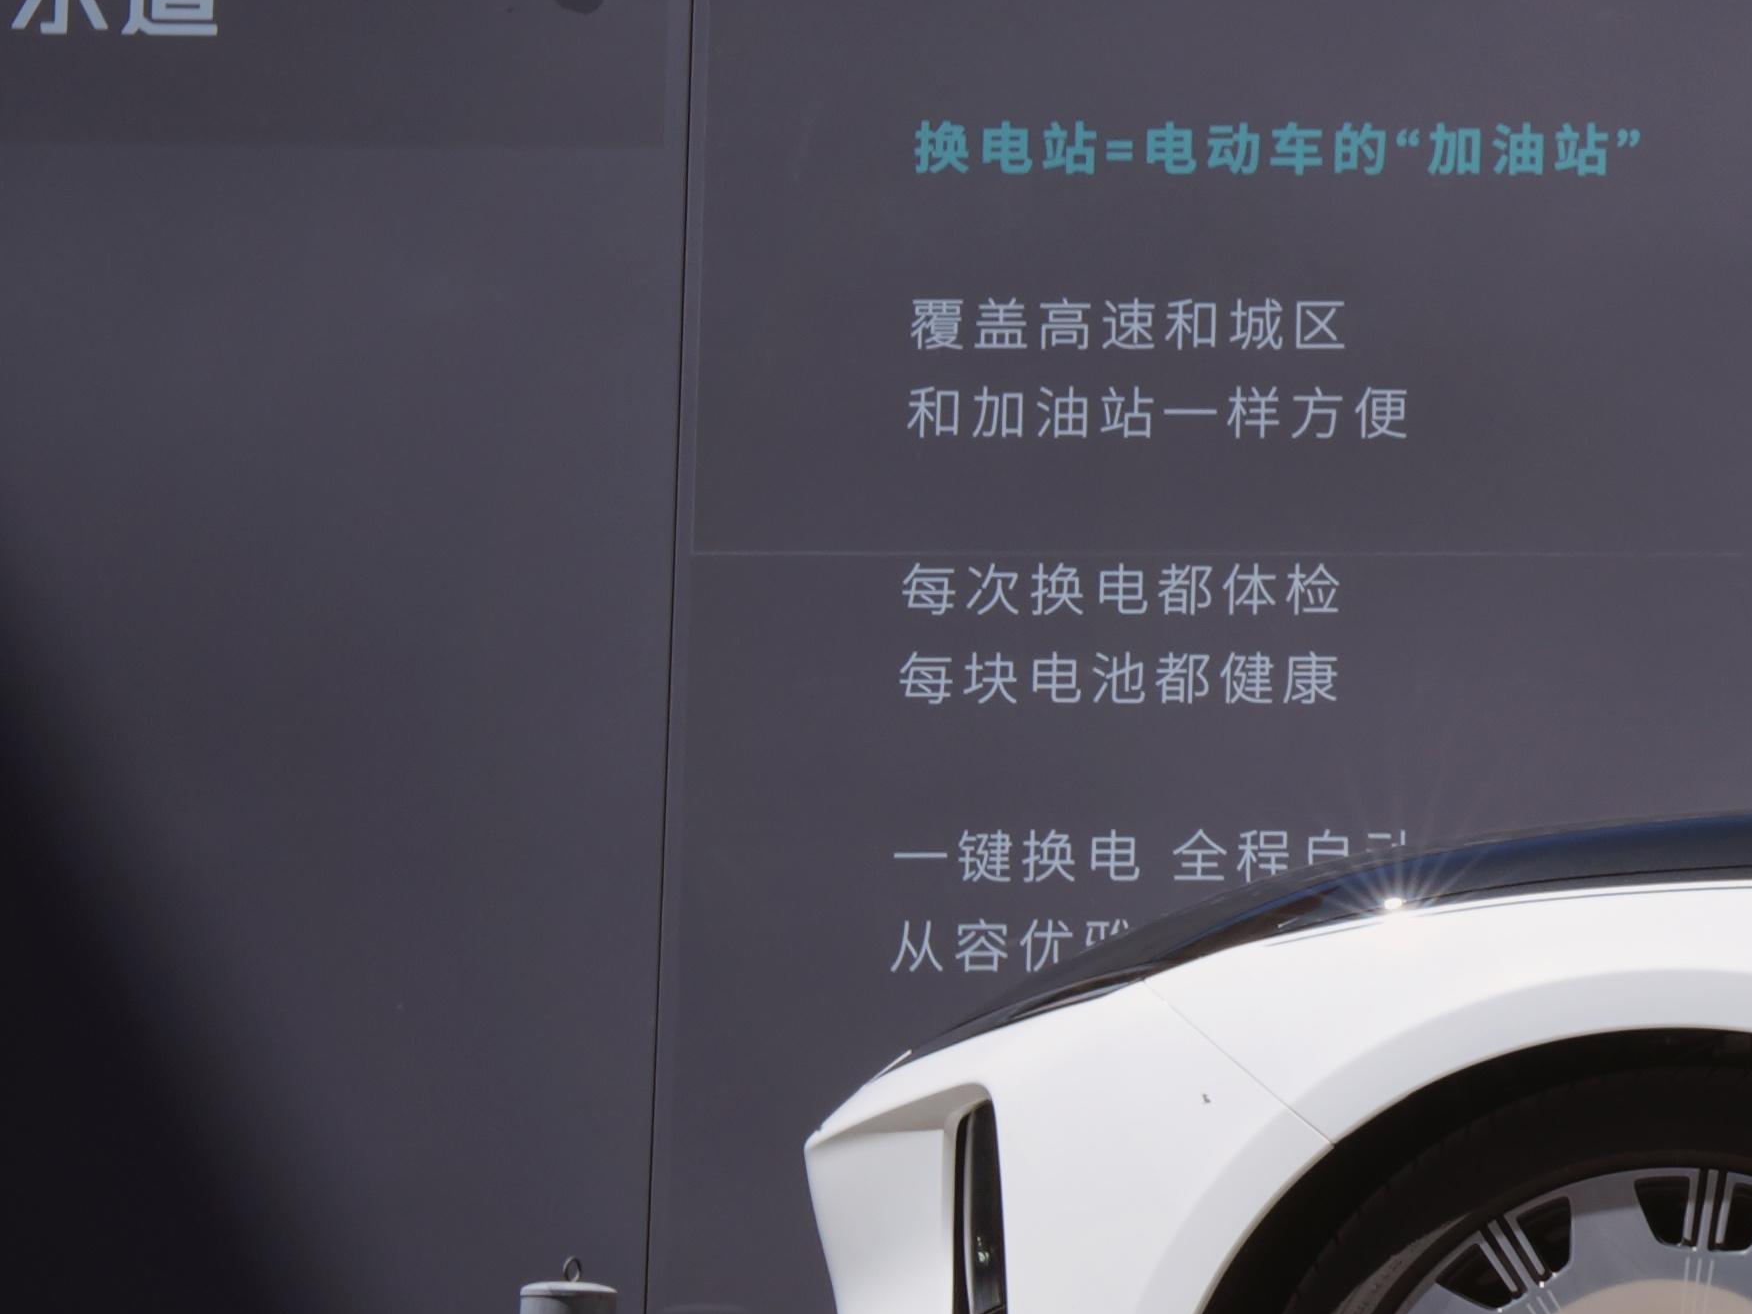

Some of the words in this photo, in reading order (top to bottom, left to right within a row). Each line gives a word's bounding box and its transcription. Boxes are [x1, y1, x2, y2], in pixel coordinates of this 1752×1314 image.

[915, 121, 1642, 175] 换电站=电动车的“加油站”
[911, 298, 1346, 350] 覆盖高速和城区
[907, 386, 1408, 439] 和加油站一样方便
[902, 563, 1340, 615] 每次换电都体检
[900, 651, 1339, 704] 每块电池都健康
[893, 829, 1140, 883] 一键换电
